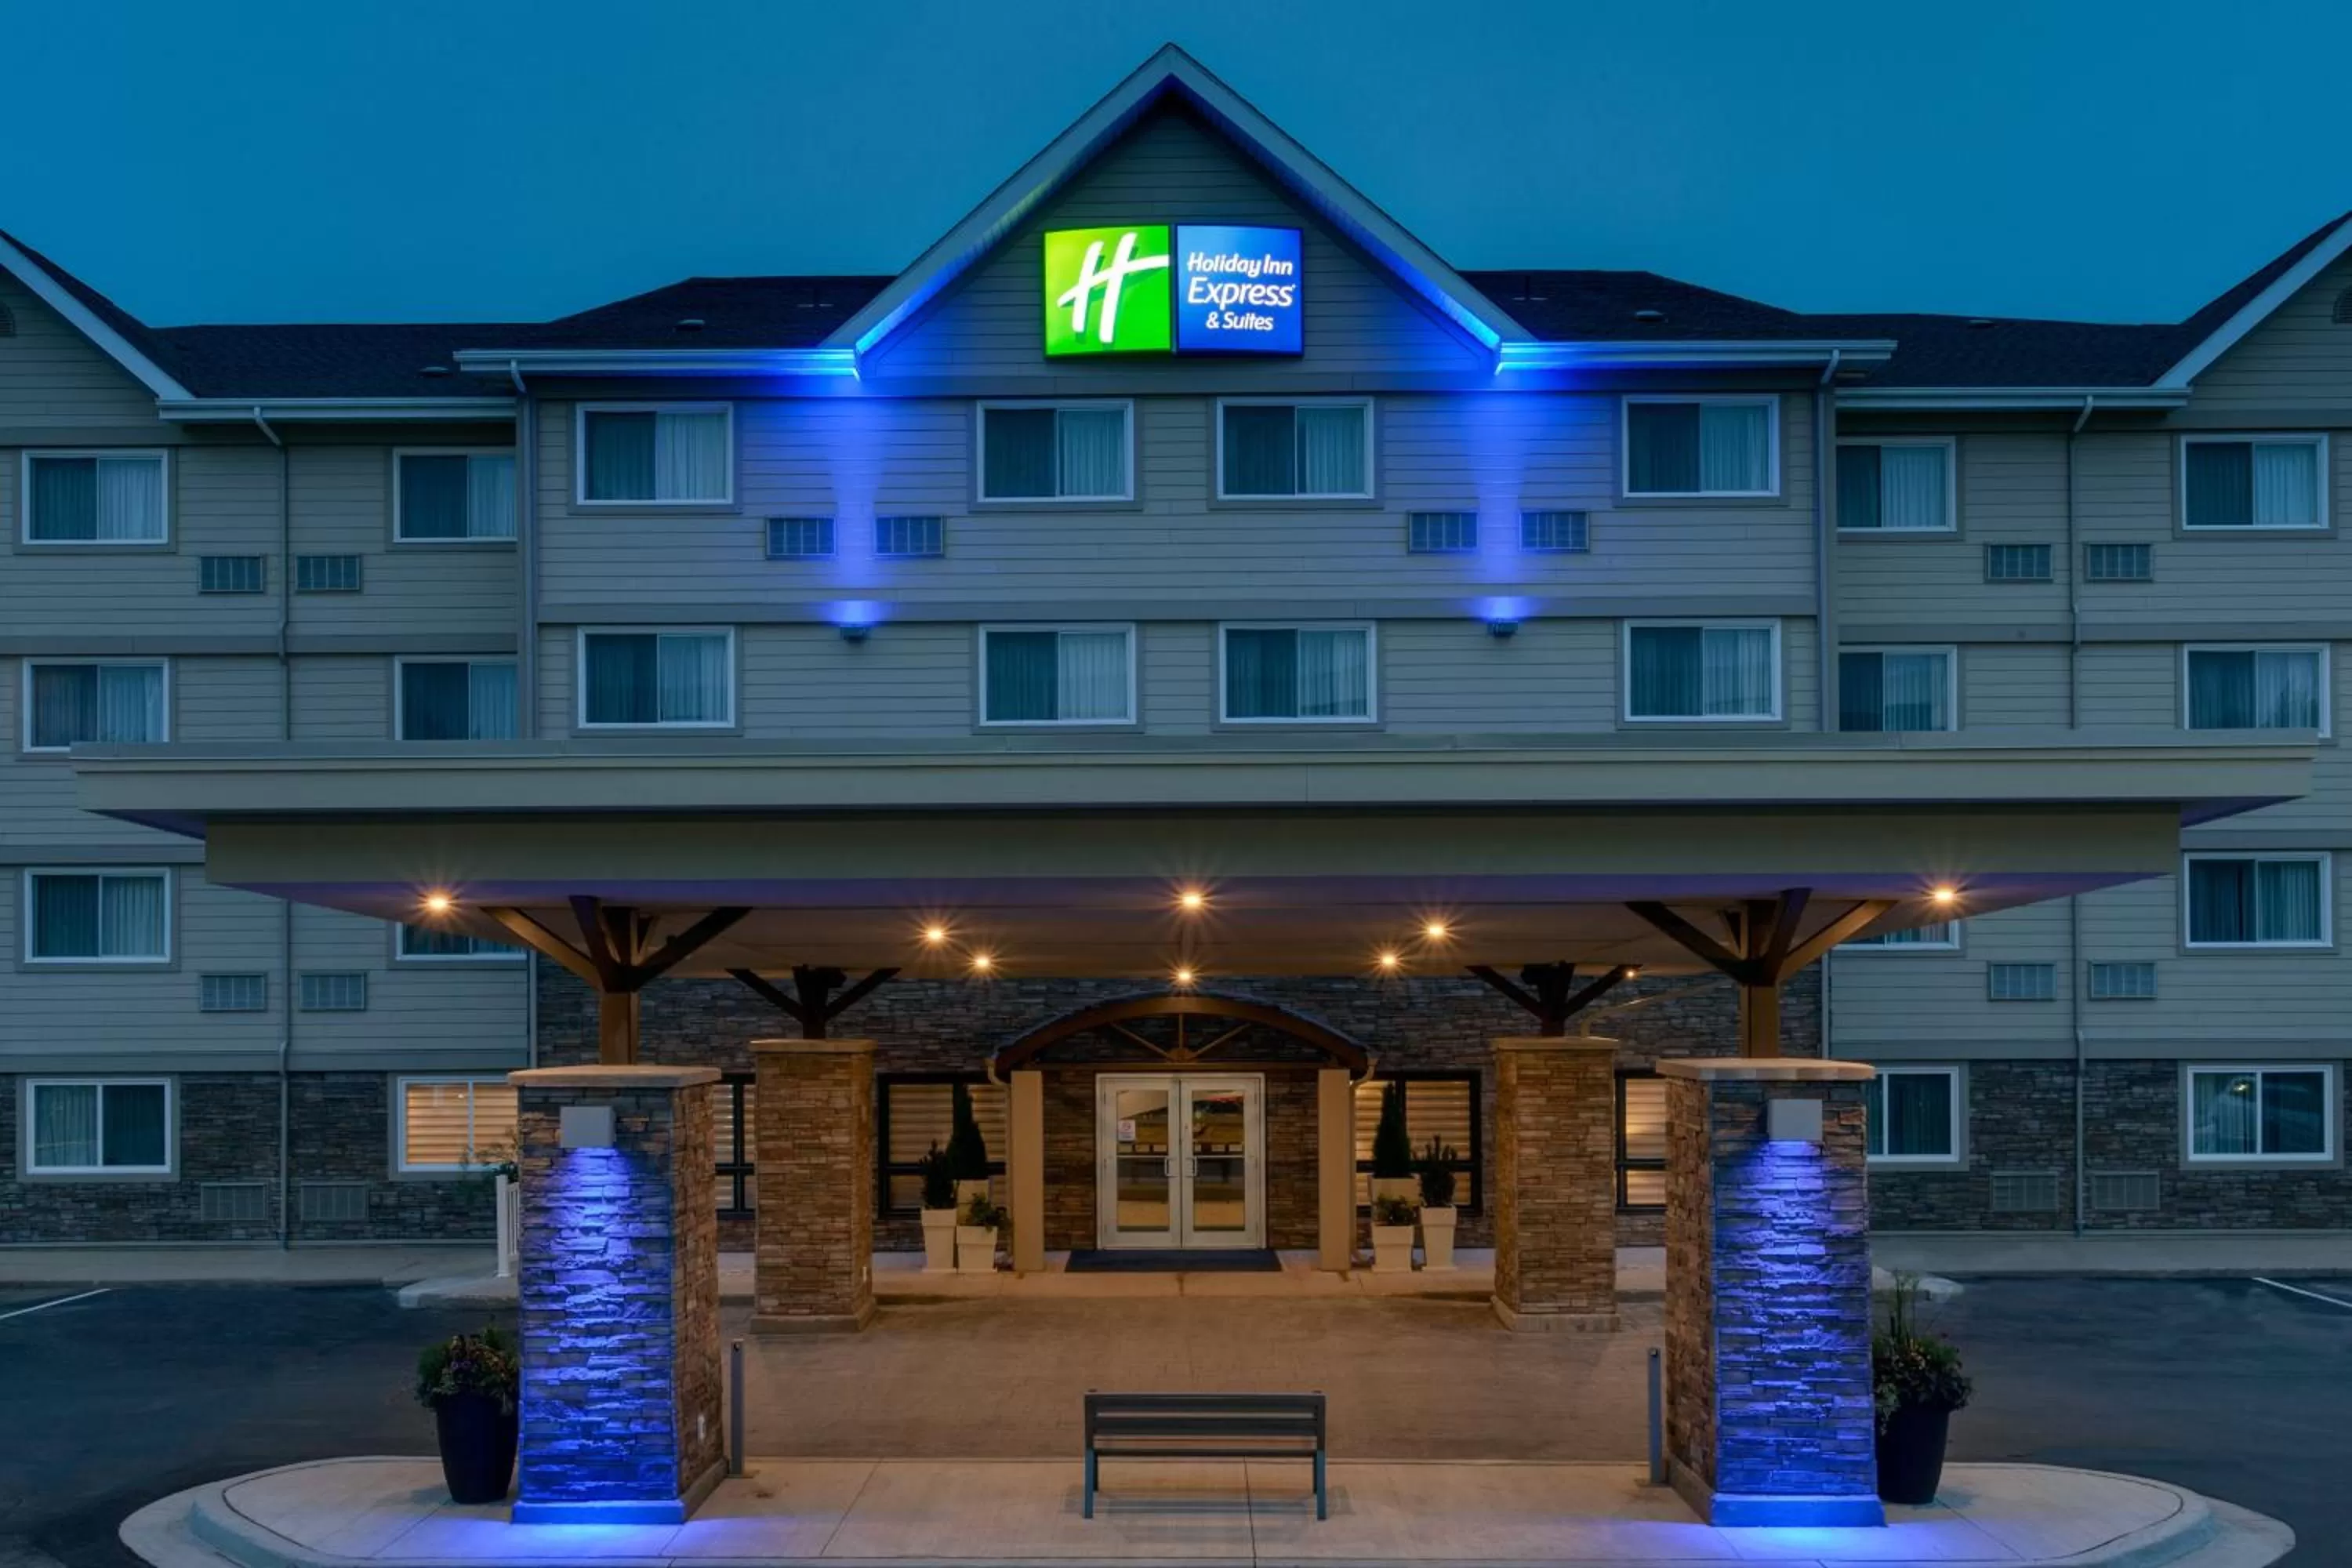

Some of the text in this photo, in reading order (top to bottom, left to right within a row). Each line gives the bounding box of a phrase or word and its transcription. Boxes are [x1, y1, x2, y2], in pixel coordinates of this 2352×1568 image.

[1187, 252, 1293, 278] Holiday Inn
[1187, 277, 1294, 310] Express
[1206, 311, 1274, 332] & Suites
